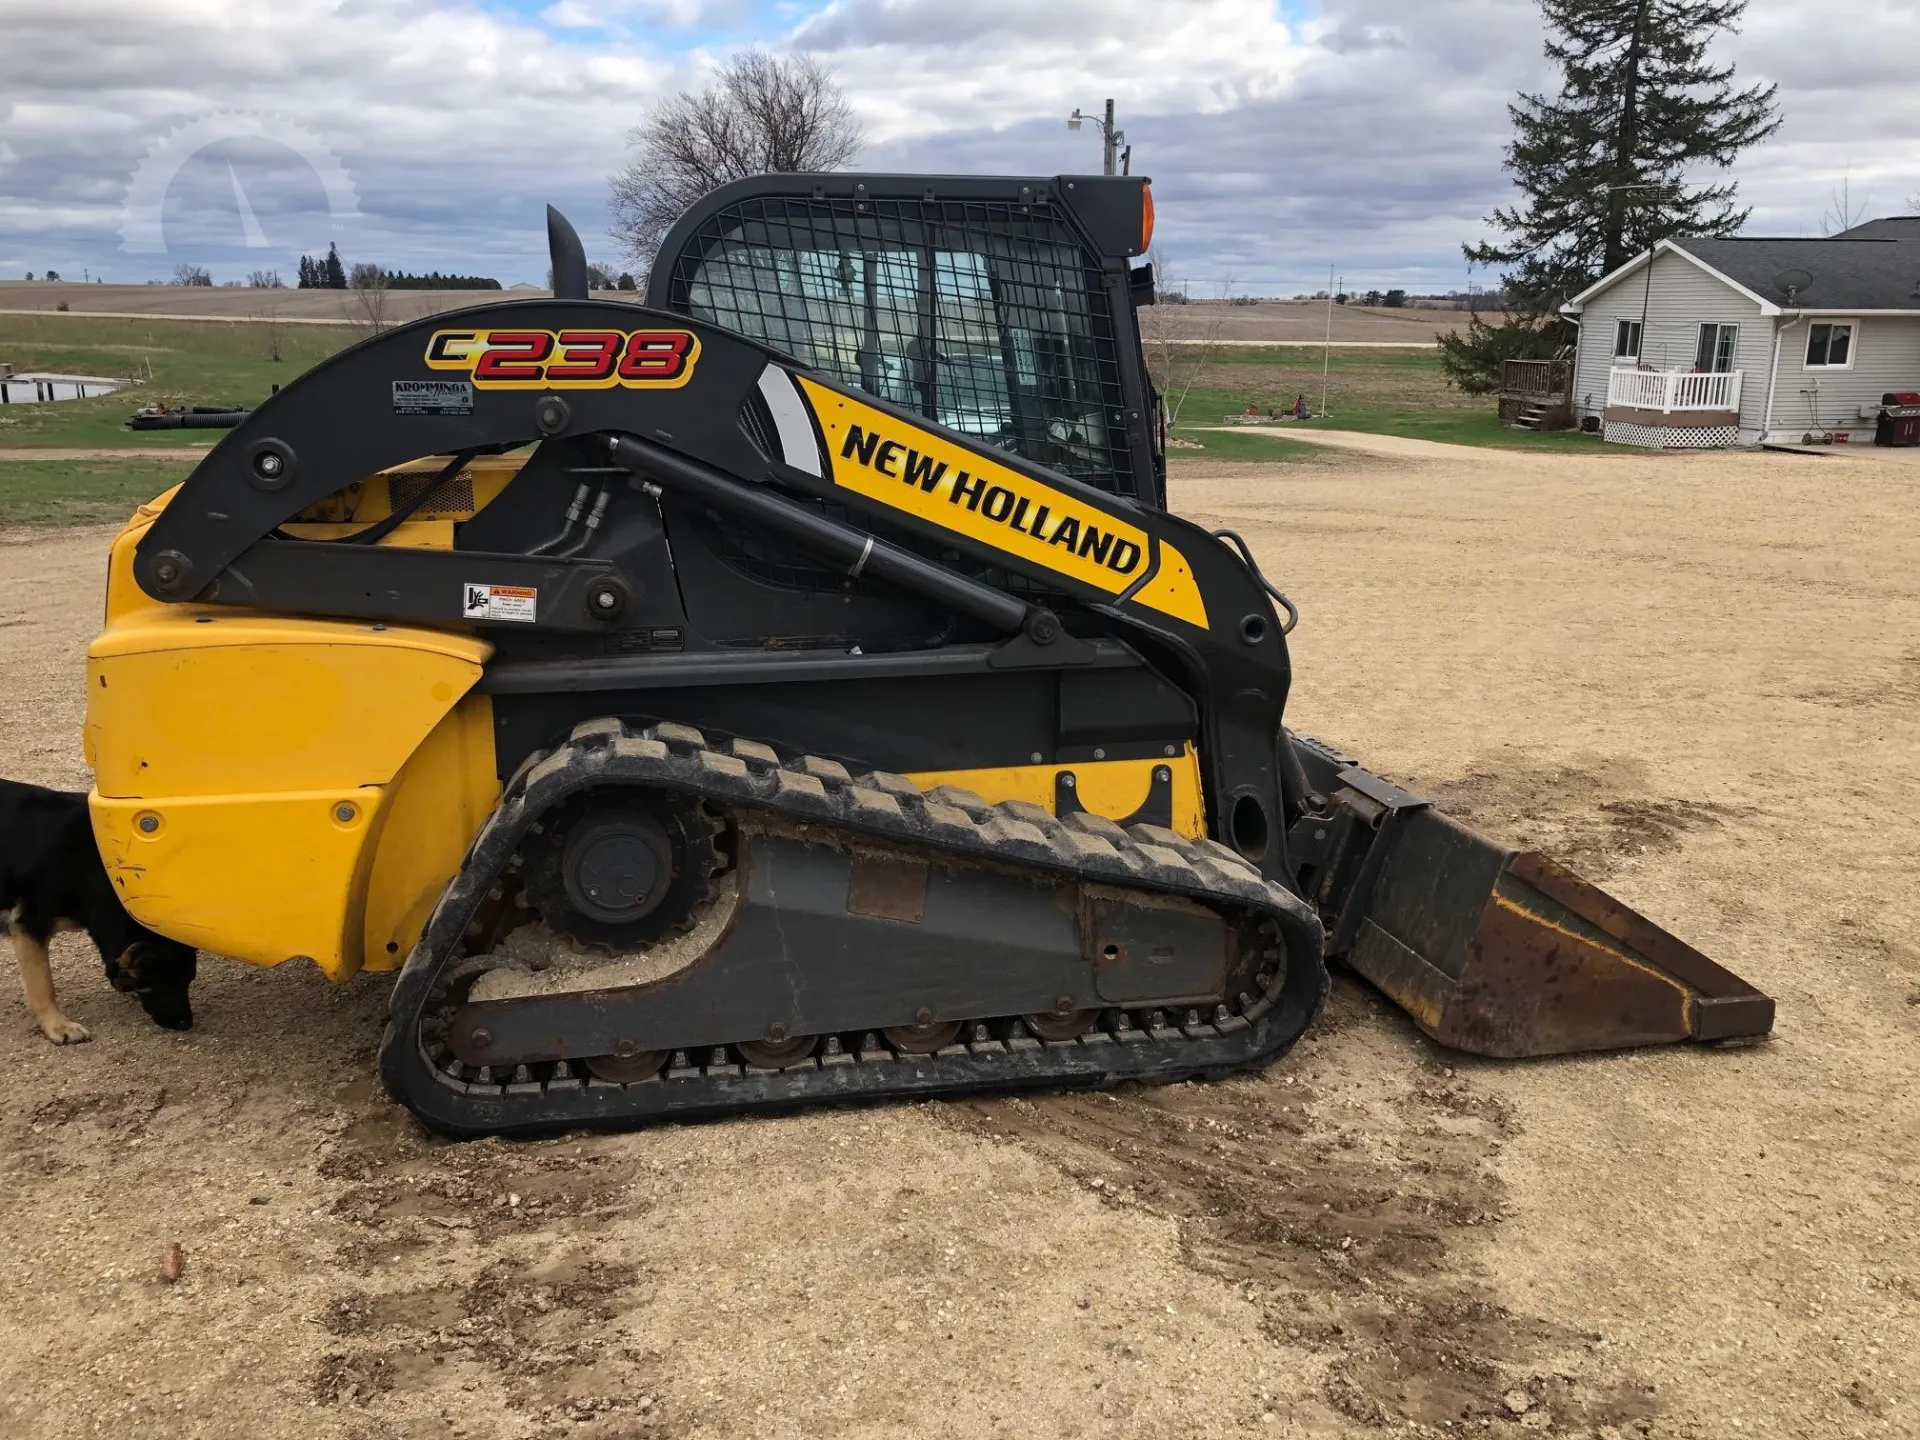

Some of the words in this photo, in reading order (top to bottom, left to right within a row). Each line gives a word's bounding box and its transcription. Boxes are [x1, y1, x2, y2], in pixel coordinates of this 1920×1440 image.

[427, 331, 698, 383] C238
[396, 382, 467, 392] KROMMINGA
[840, 424, 949, 494] NEW
[948, 470, 1142, 575] HOLLAND
[501, 589, 532, 597] WARNING
